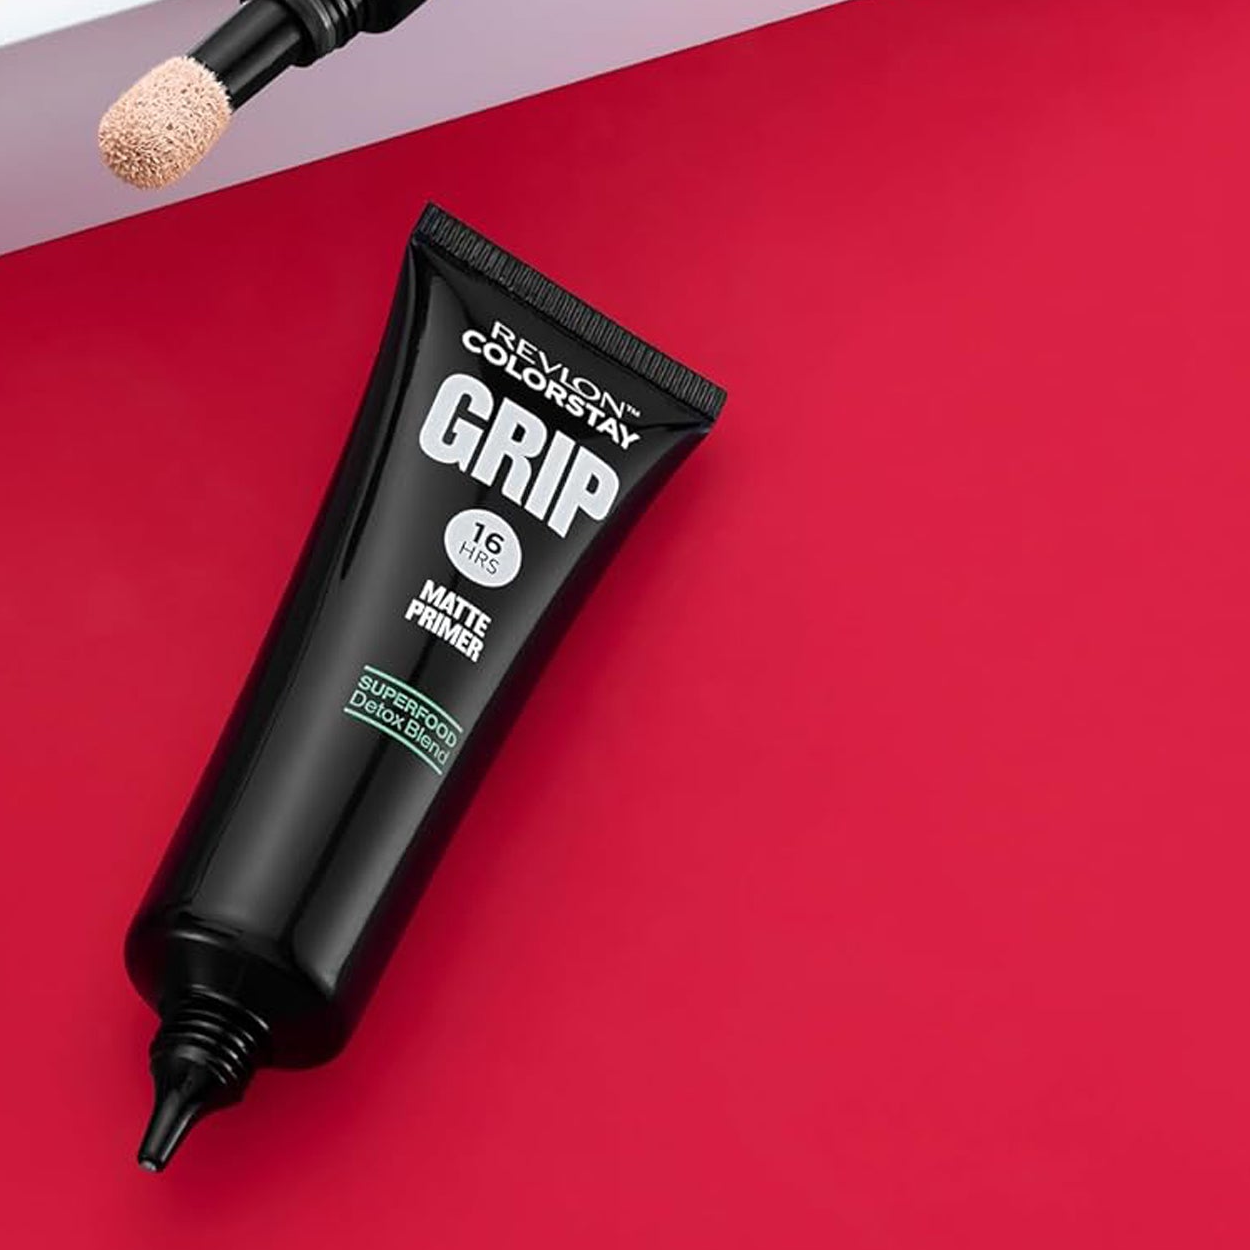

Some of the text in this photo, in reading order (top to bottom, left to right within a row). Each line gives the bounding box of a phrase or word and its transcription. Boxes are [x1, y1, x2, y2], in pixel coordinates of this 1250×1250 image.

[462, 329, 641, 450] COLORSTAY
[418, 372, 621, 539] GRIP
[458, 541, 500, 576] HRS
[471, 522, 503, 554] 16
[404, 599, 485, 663] PRIMER
[418, 579, 492, 637] MATTE
[349, 689, 450, 766] Detox Blend
[358, 674, 458, 748] SUPERFOOD
